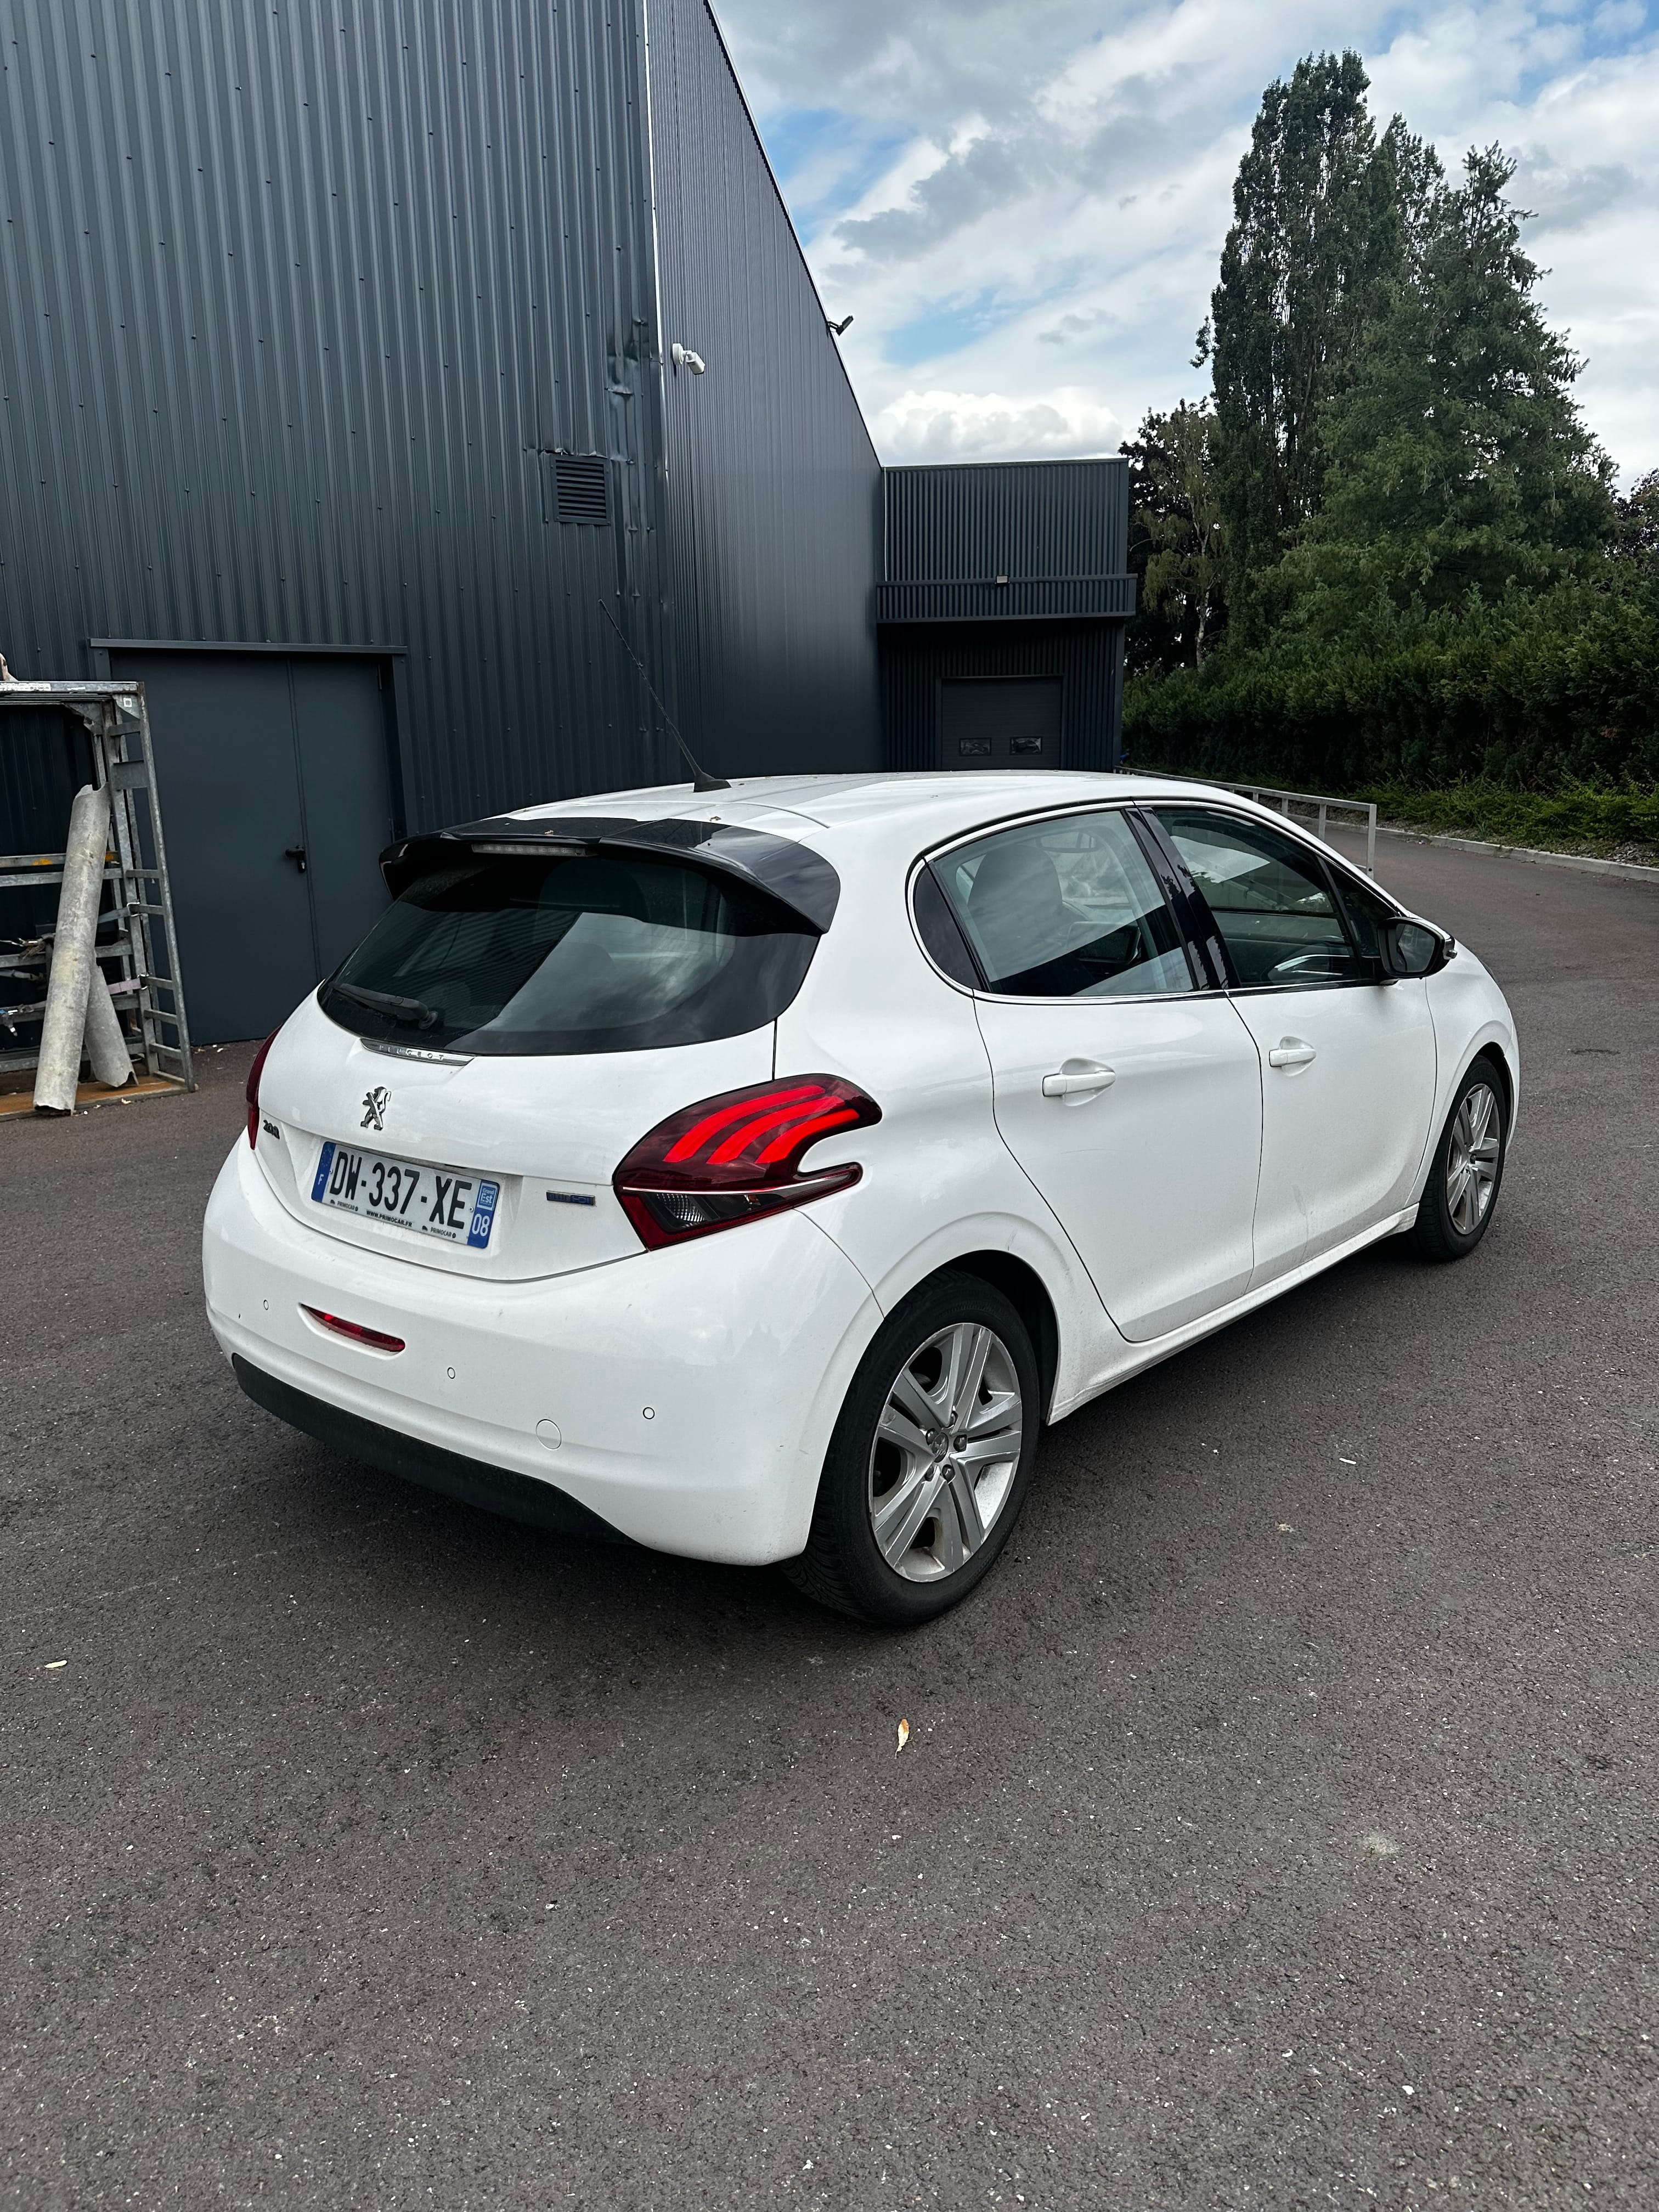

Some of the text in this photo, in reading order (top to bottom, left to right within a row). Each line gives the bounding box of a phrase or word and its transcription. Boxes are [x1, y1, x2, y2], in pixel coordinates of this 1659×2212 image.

[318, 1173, 324, 1185] F
[330, 1151, 472, 1229] DW-337-XE
[366, 1210, 412, 1227] WWW.PRIMOCAR.FR
[472, 1214, 490, 1237] 08
